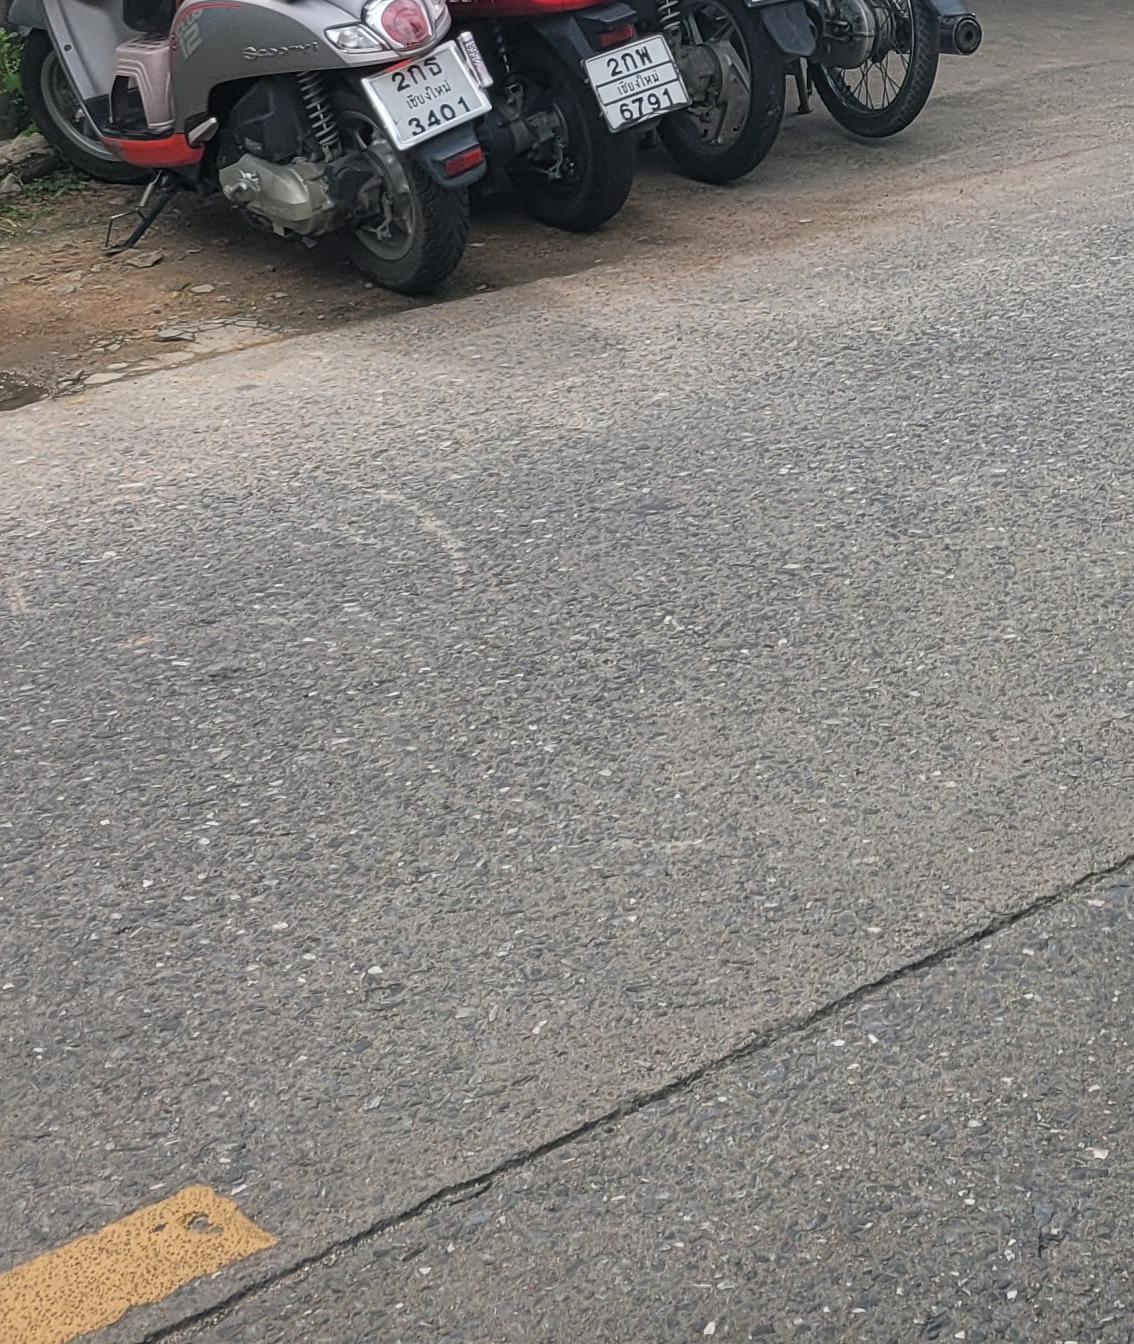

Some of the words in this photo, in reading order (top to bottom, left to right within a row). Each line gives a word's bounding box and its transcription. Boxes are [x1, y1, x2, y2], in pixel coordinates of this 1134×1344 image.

[391, 56, 442, 92] 2กธ
[617, 69, 660, 95] เชียงใหม่
[405, 80, 452, 109] เชียงใหม่
[619, 88, 674, 121] 6791
[408, 96, 471, 137] 3401
